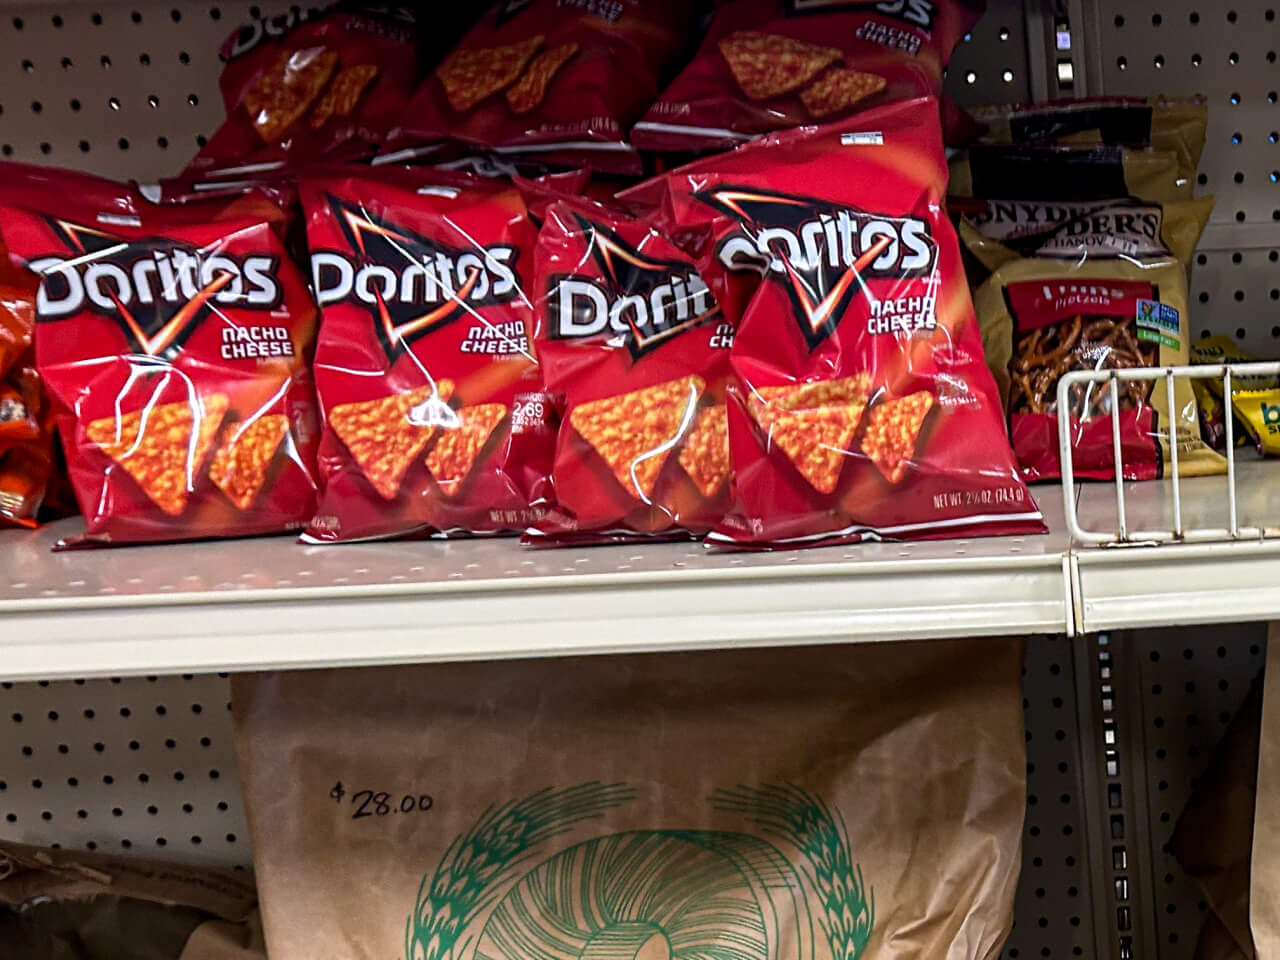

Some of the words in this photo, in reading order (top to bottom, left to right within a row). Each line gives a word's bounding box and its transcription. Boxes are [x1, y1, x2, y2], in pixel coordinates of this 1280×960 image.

[29, 249, 278, 316] Doritos
[310, 247, 517, 306] Doritos
[559, 272, 711, 336] Dorit
[222, 326, 289, 342] NACHO
[468, 320, 526, 340] NACHO
[221, 341, 294, 359] CHEESE
[460, 337, 529, 354] CHEESE
[329, 779, 434, 820] $28.00
